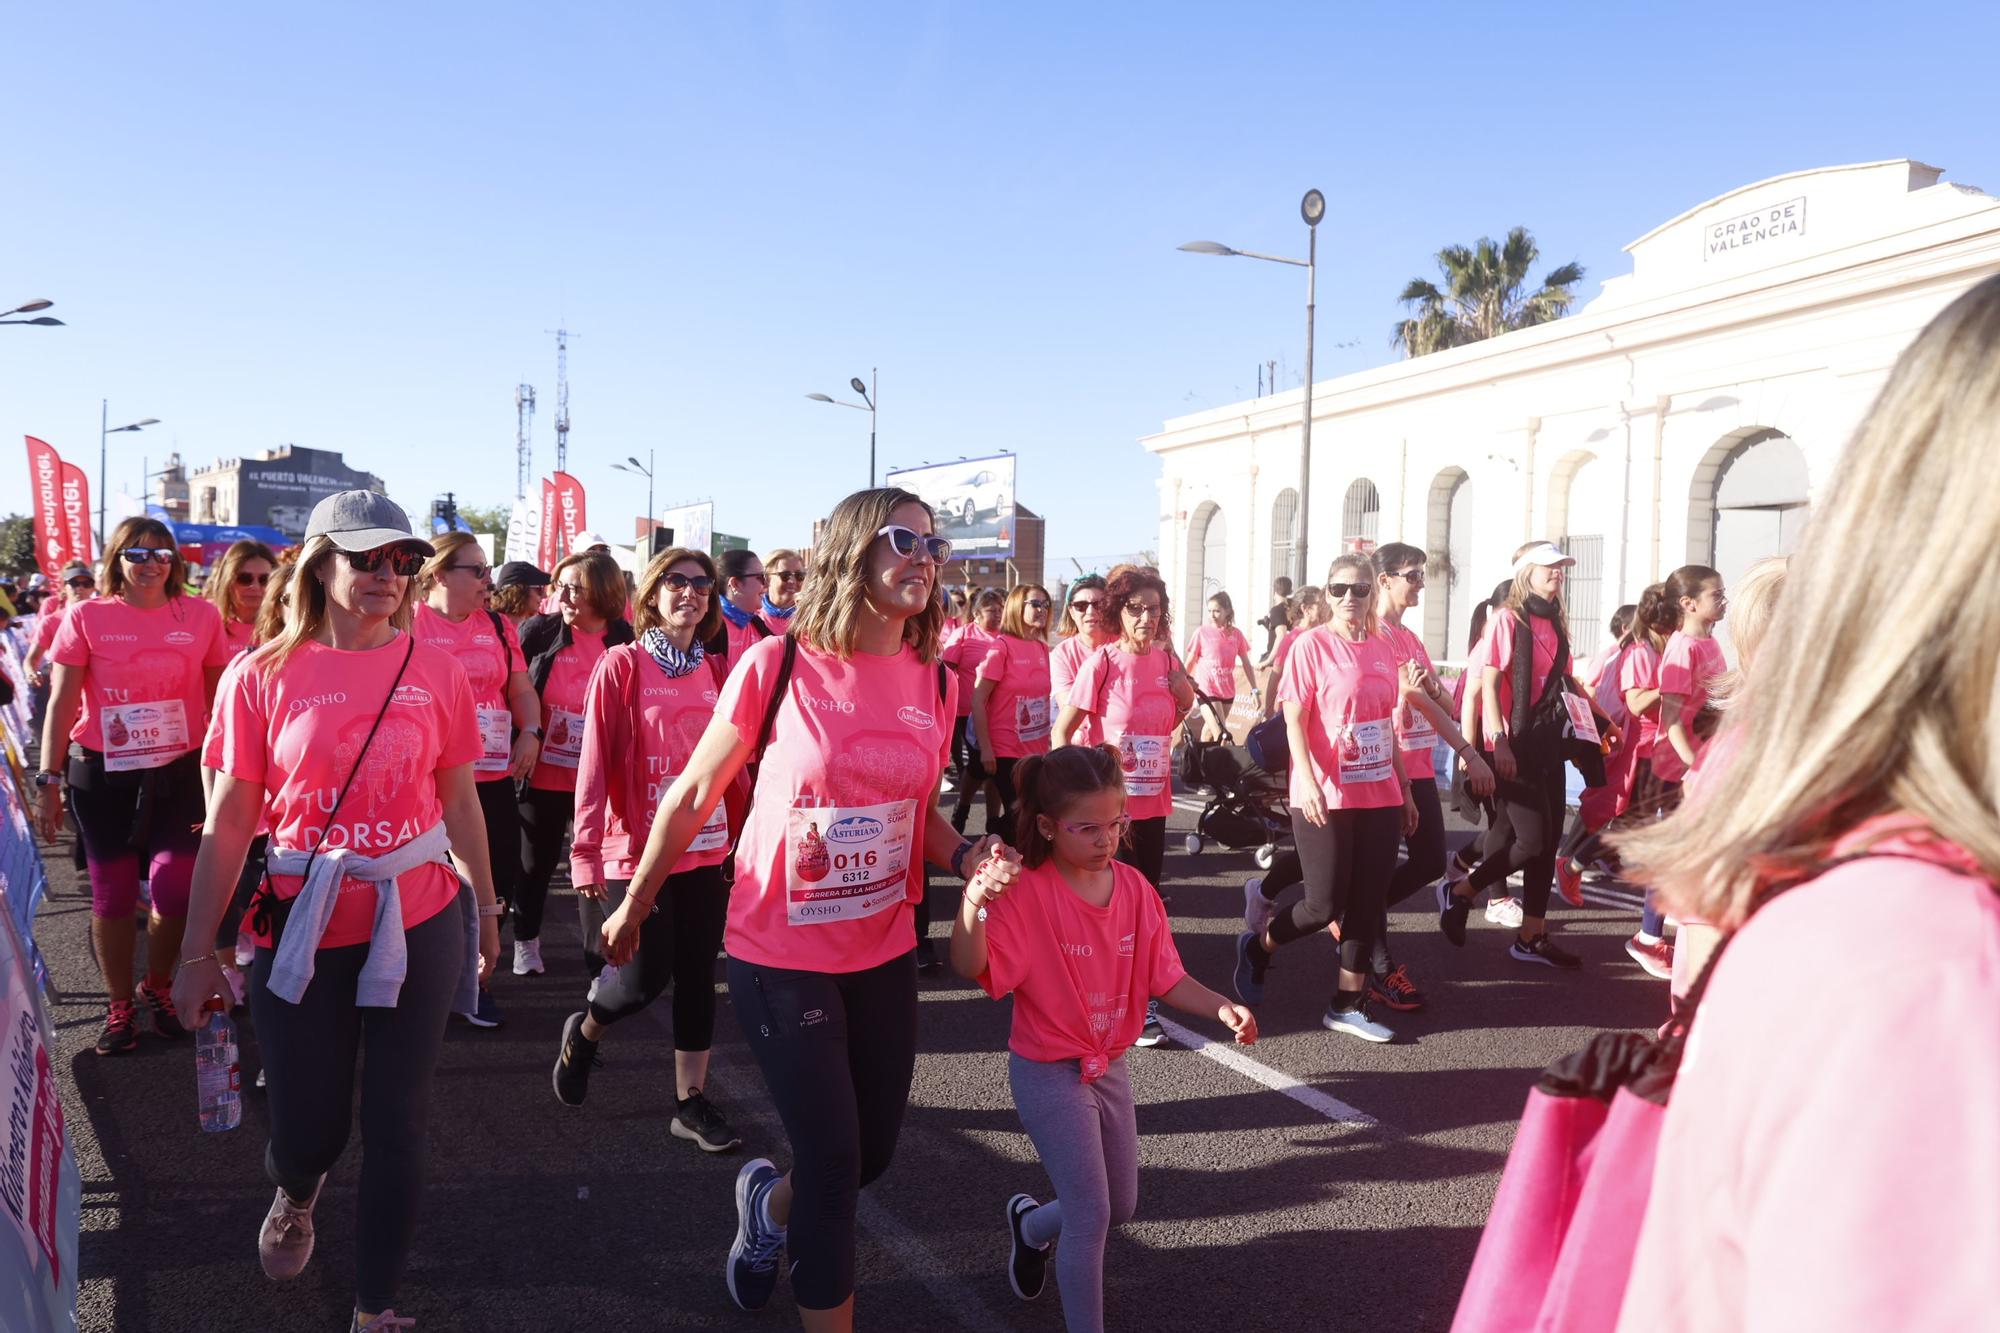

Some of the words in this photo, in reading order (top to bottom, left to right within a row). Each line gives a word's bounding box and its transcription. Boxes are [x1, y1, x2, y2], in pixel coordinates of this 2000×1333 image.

[1714, 216, 1760, 239] GRAO
[1770, 204, 1796, 222] DE
[1710, 220, 1797, 254] VALENCIA
[100, 633, 138, 642] OYSHO
[103, 687, 128, 703] TU
[643, 687, 679, 697] OYSHO
[289, 692, 347, 712] OYSHO
[800, 695, 855, 713] OYSHO
[131, 727, 160, 740] 016
[1362, 744, 1380, 755] 016
[647, 756, 671, 775] TU
[1140, 759, 1158, 768] 016
[300, 788, 337, 813] TU
[831, 826, 880, 839] ASTURIANA
[834, 850, 878, 869] 016
[842, 870, 870, 883] 6312
[804, 890, 840, 899] CARRERA
[841, 888, 852, 896] DE
[864, 881, 887, 892] MUJER
[801, 905, 841, 916] OYSHO
